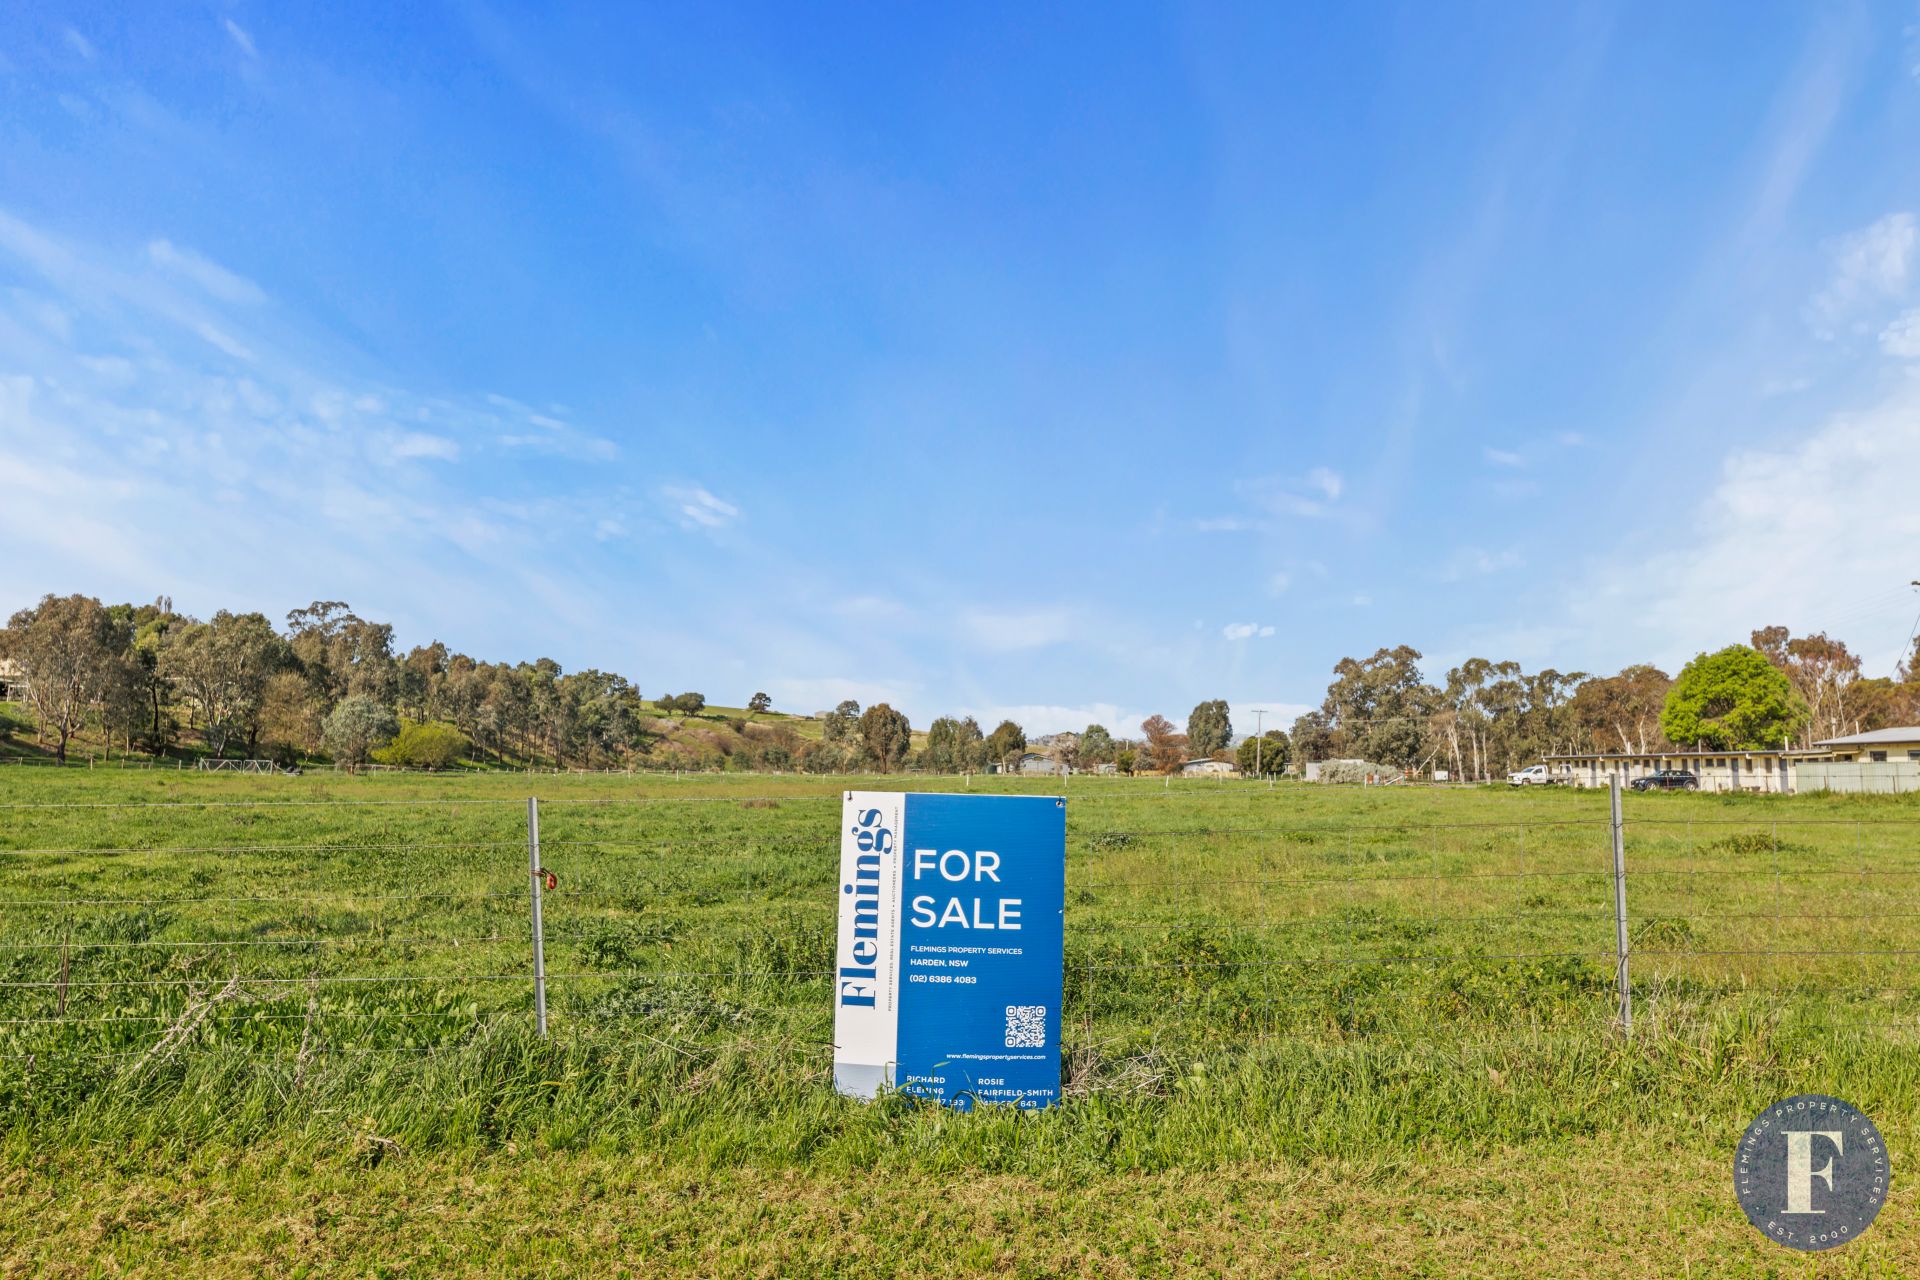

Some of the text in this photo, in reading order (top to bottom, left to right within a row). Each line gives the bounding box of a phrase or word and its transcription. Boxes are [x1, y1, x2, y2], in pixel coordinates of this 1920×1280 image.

[913, 849, 1001, 882] FOR
[840, 808, 893, 1010] Flemings
[910, 895, 1022, 930] SALE
[910, 945, 1022, 955] FLEMINGS PROPERTY SERVICES
[909, 975, 977, 984] (02) 6386 4083
[946, 1053, 1046, 1061] www.flemingspropertyservices.com
[906, 1075, 946, 1084] RICHARD
[978, 1078, 1005, 1086] ROSIE
[977, 1089, 1054, 1097] FAIRFIELD-SMITH
